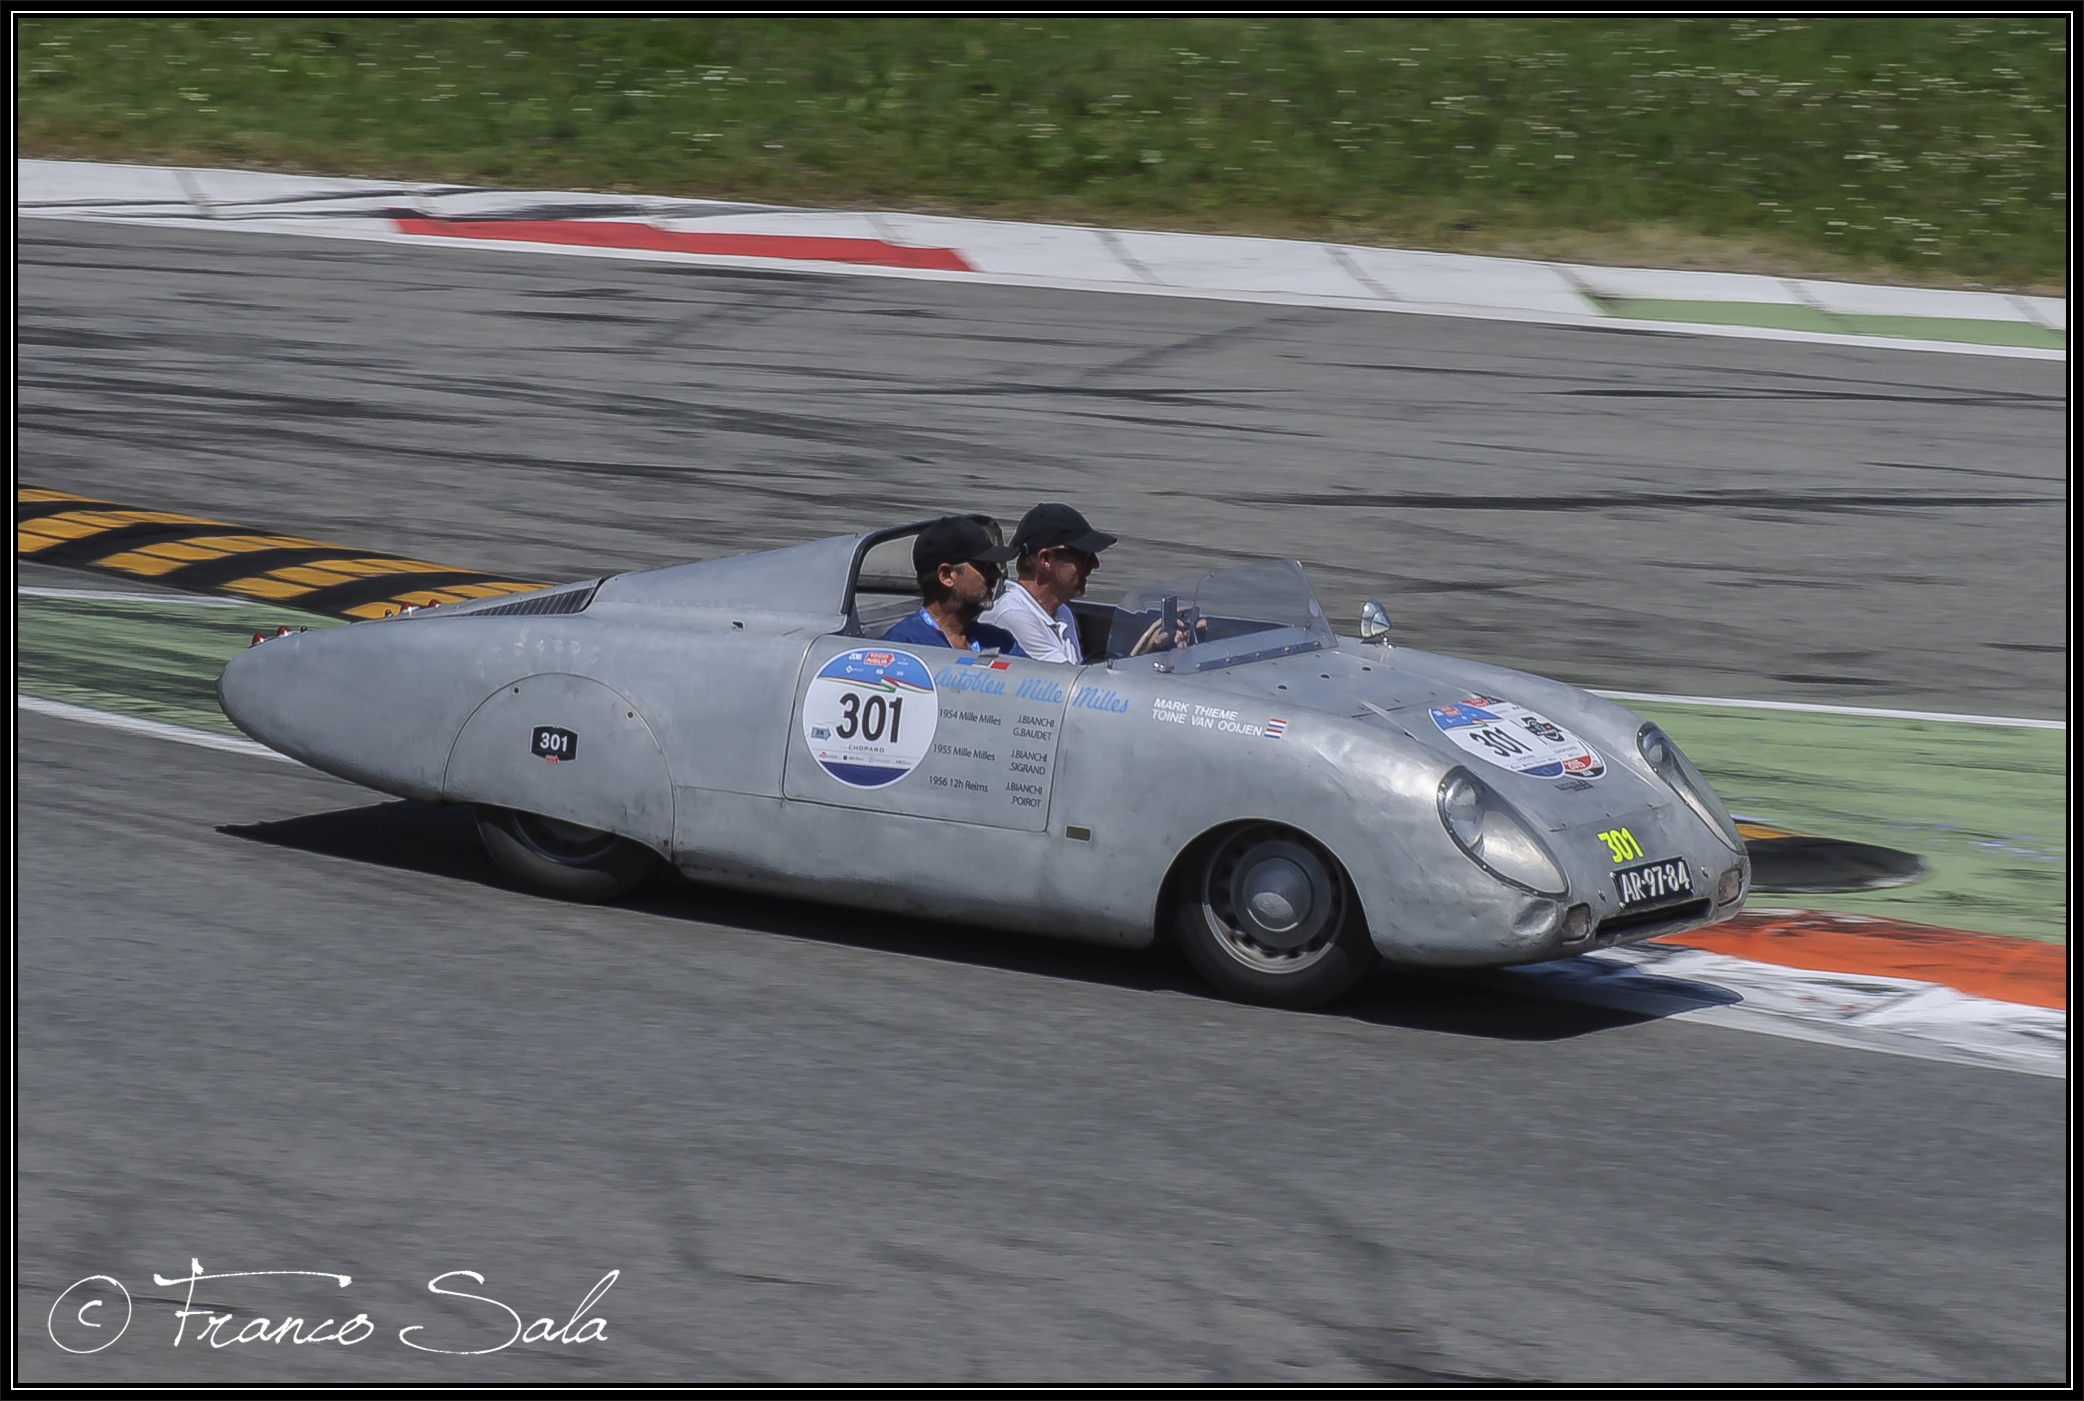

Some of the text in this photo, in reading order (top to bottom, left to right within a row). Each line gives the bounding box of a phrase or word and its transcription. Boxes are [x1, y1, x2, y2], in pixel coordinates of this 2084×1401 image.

[934, 666, 1130, 714] Autobleu Mille Milles
[836, 693, 903, 743] 301
[940, 708, 1001, 726] 1954 Mille Milles
[1153, 698, 1239, 721] MARK THIEME
[1152, 708, 1263, 737] TOINE VAN OOIJEN
[540, 732, 568, 752] 301
[1012, 727, 1052, 741] G.BAUDET
[1469, 726, 1533, 757] 301
[848, 744, 885, 753] CHOPARD
[933, 744, 996, 761] 1955 Mille Milles
[929, 775, 988, 793] 1956 12h Reims
[1597, 827, 1644, 863] 301
